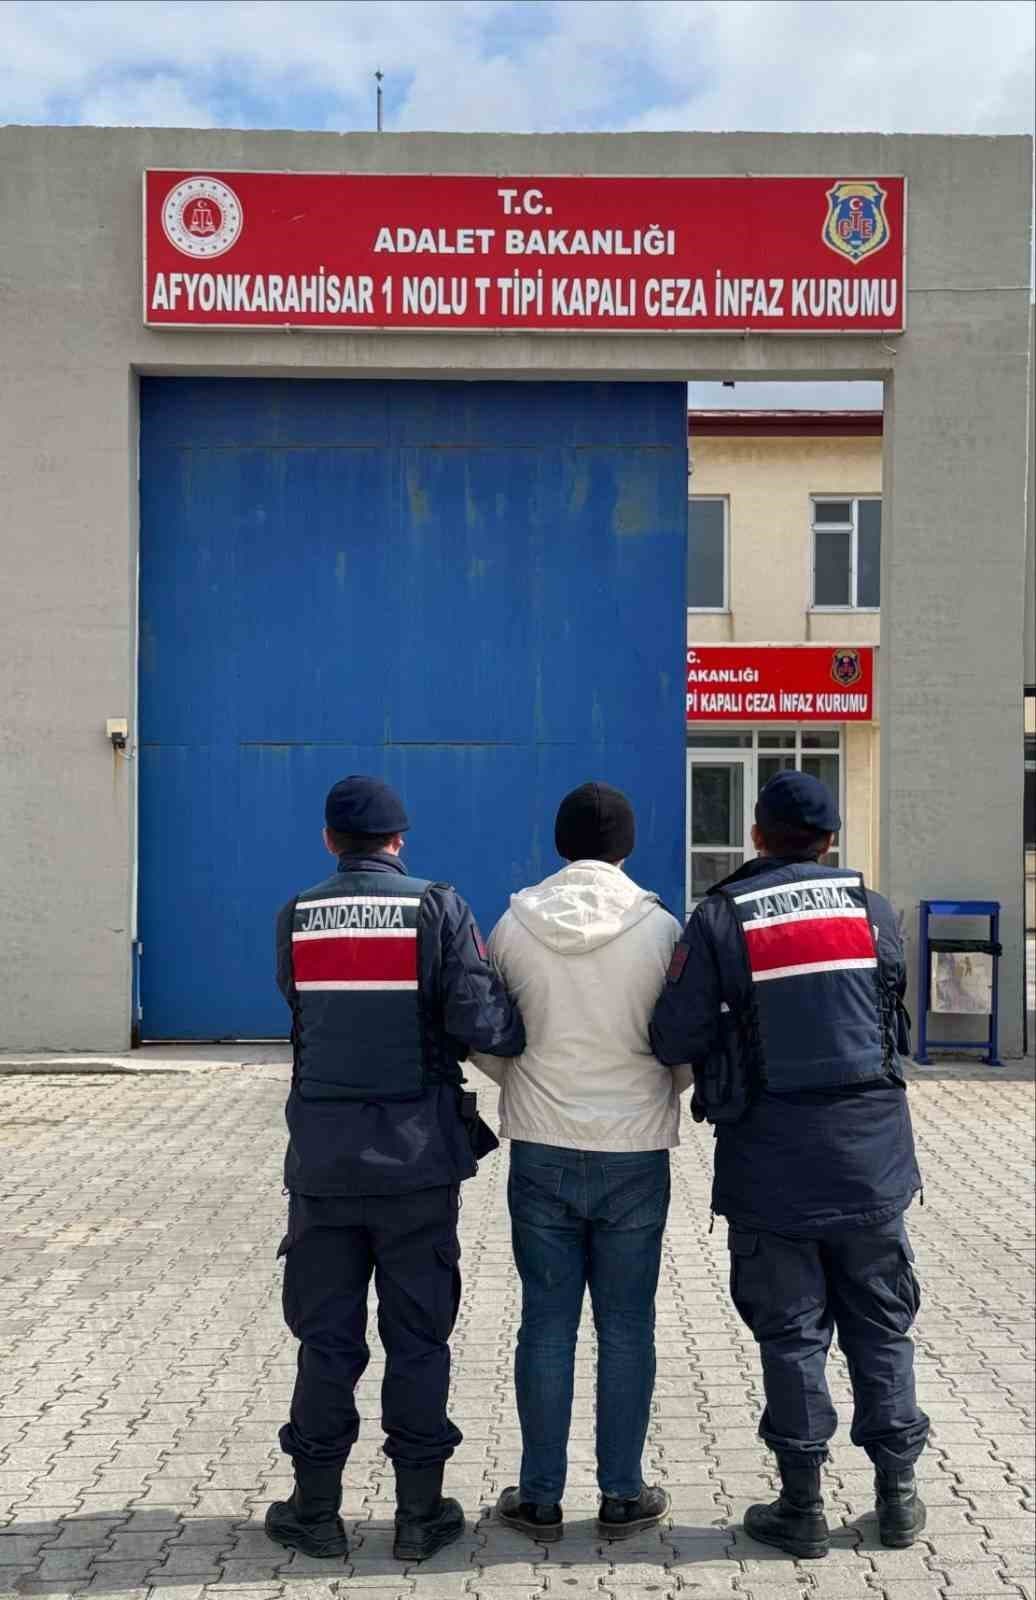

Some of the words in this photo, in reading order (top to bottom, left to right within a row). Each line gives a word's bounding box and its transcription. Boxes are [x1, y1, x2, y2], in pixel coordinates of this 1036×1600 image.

[498, 189, 553, 215] T.C.
[373, 227, 496, 254] ADALET
[505, 223, 675, 256] BAKANLIĞI
[151, 265, 374, 314] AFYONKARAHİSAR
[381, 275, 393, 314] 1
[402, 276, 468, 316] NOLU
[474, 277, 491, 315] T
[497, 268, 543, 316] TİPİ
[550, 277, 636, 317] KAPALI
[643, 278, 708, 317] CEZA
[714, 269, 784, 317] İNFAZ
[791, 278, 897, 317] KURUMU
[687, 651, 701, 664] C.
[688, 668, 759, 683] AKANLIĞI
[686, 689, 698, 712] Pİ
[700, 693, 743, 713] KAPALI
[745, 693, 777, 713] CEZA
[779, 689, 814, 713] İNFAZ
[815, 693, 868, 713] KURUMU
[754, 885, 855, 920] JANDARMA
[301, 904, 405, 932] JANDARMA
